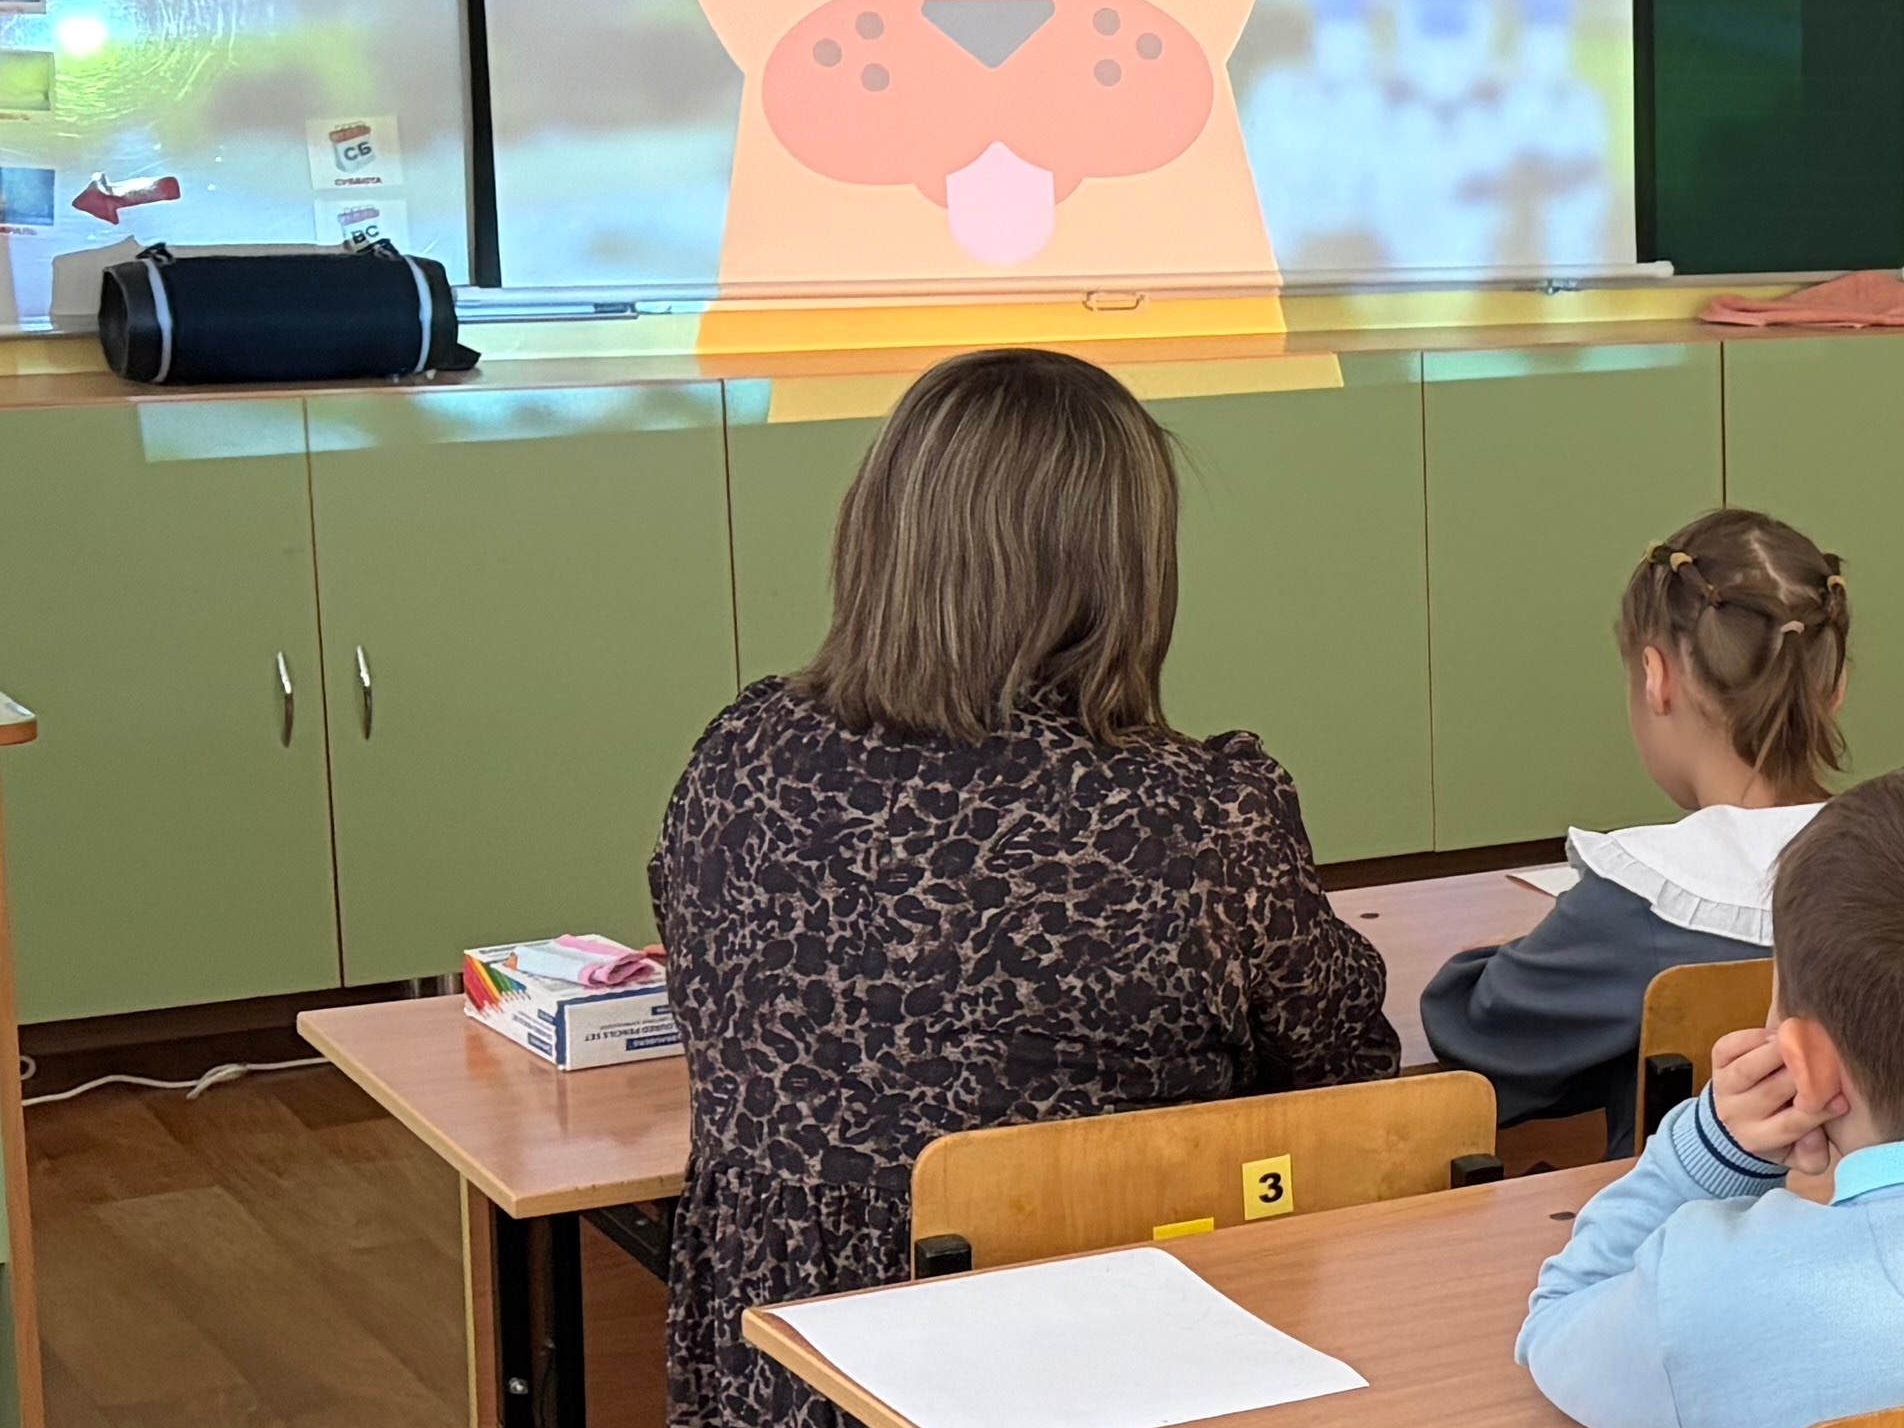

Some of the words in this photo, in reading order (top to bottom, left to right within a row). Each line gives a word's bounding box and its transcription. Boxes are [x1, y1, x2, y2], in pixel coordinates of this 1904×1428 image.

[344, 142, 372, 161] СБ
[351, 225, 380, 245] ВС
[584, 1032, 601, 1041] SET
[603, 1027, 640, 1039] PENCILS
[1258, 1172, 1284, 1203] 3
